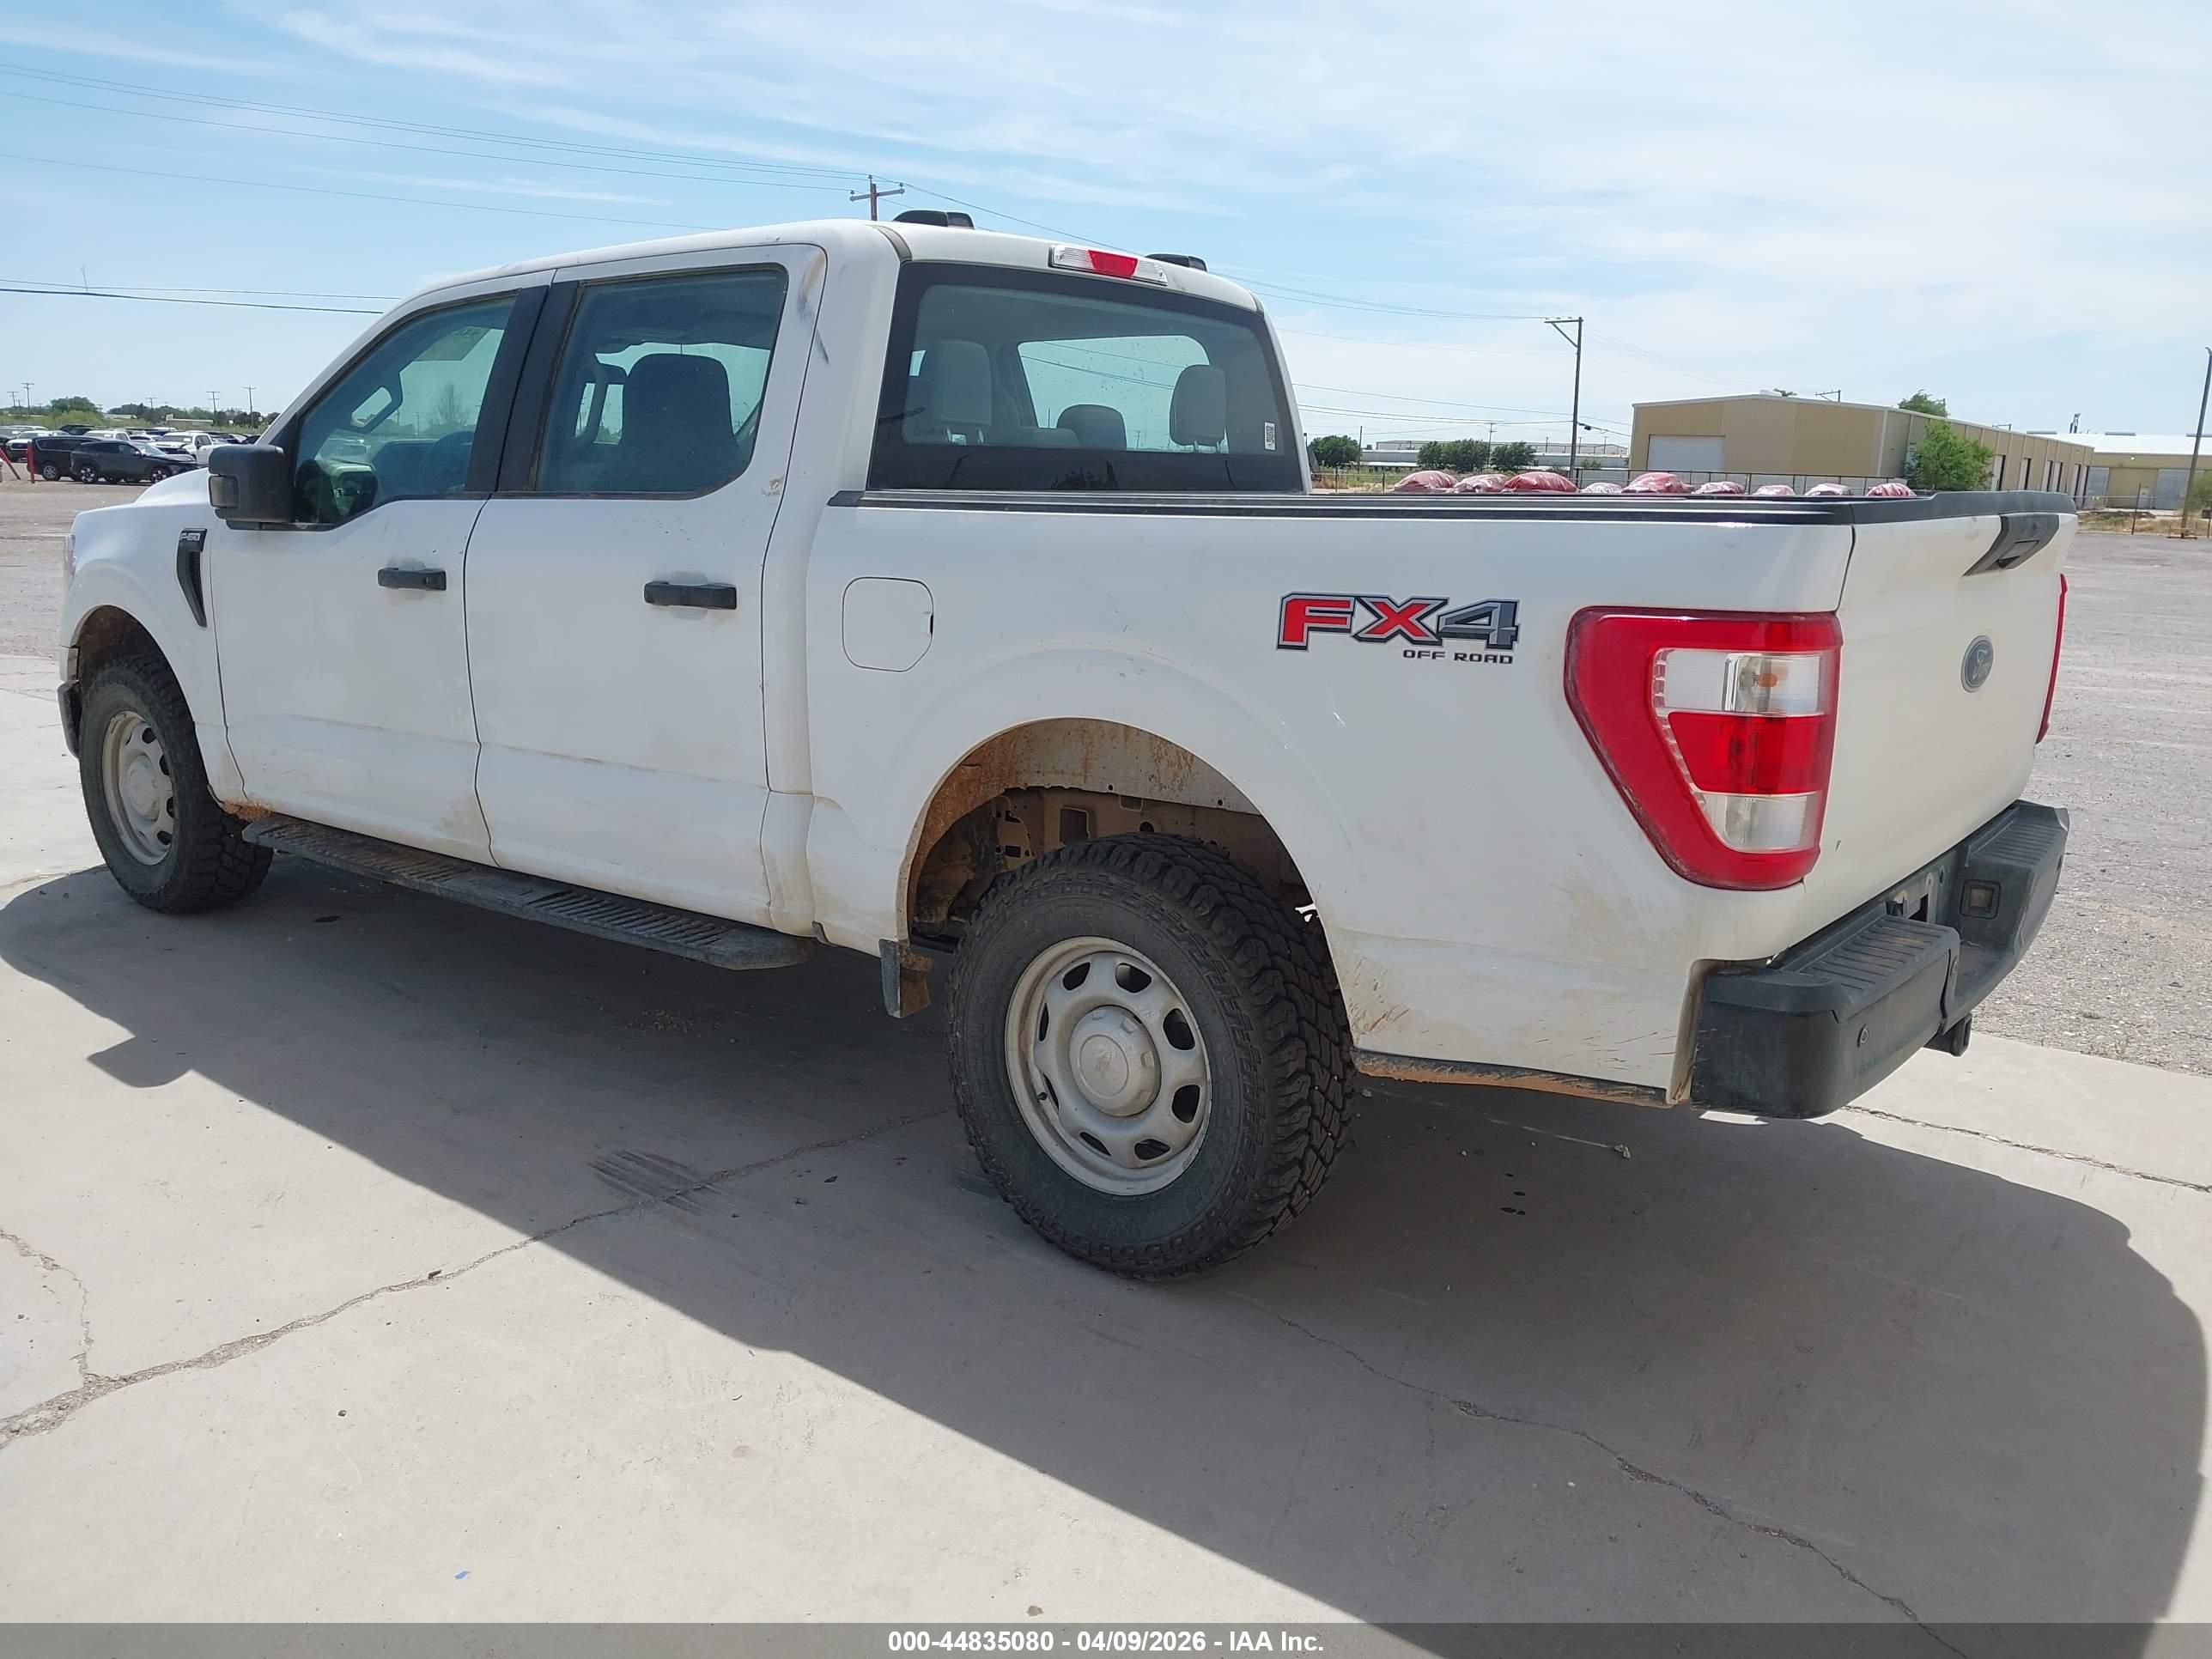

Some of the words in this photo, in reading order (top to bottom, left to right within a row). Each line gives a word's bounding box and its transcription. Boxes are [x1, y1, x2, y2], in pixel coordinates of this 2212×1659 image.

[1277, 592, 1520, 651] FX4
[1403, 649, 1446, 660] OFF
[1454, 653, 1513, 665] ROAD
